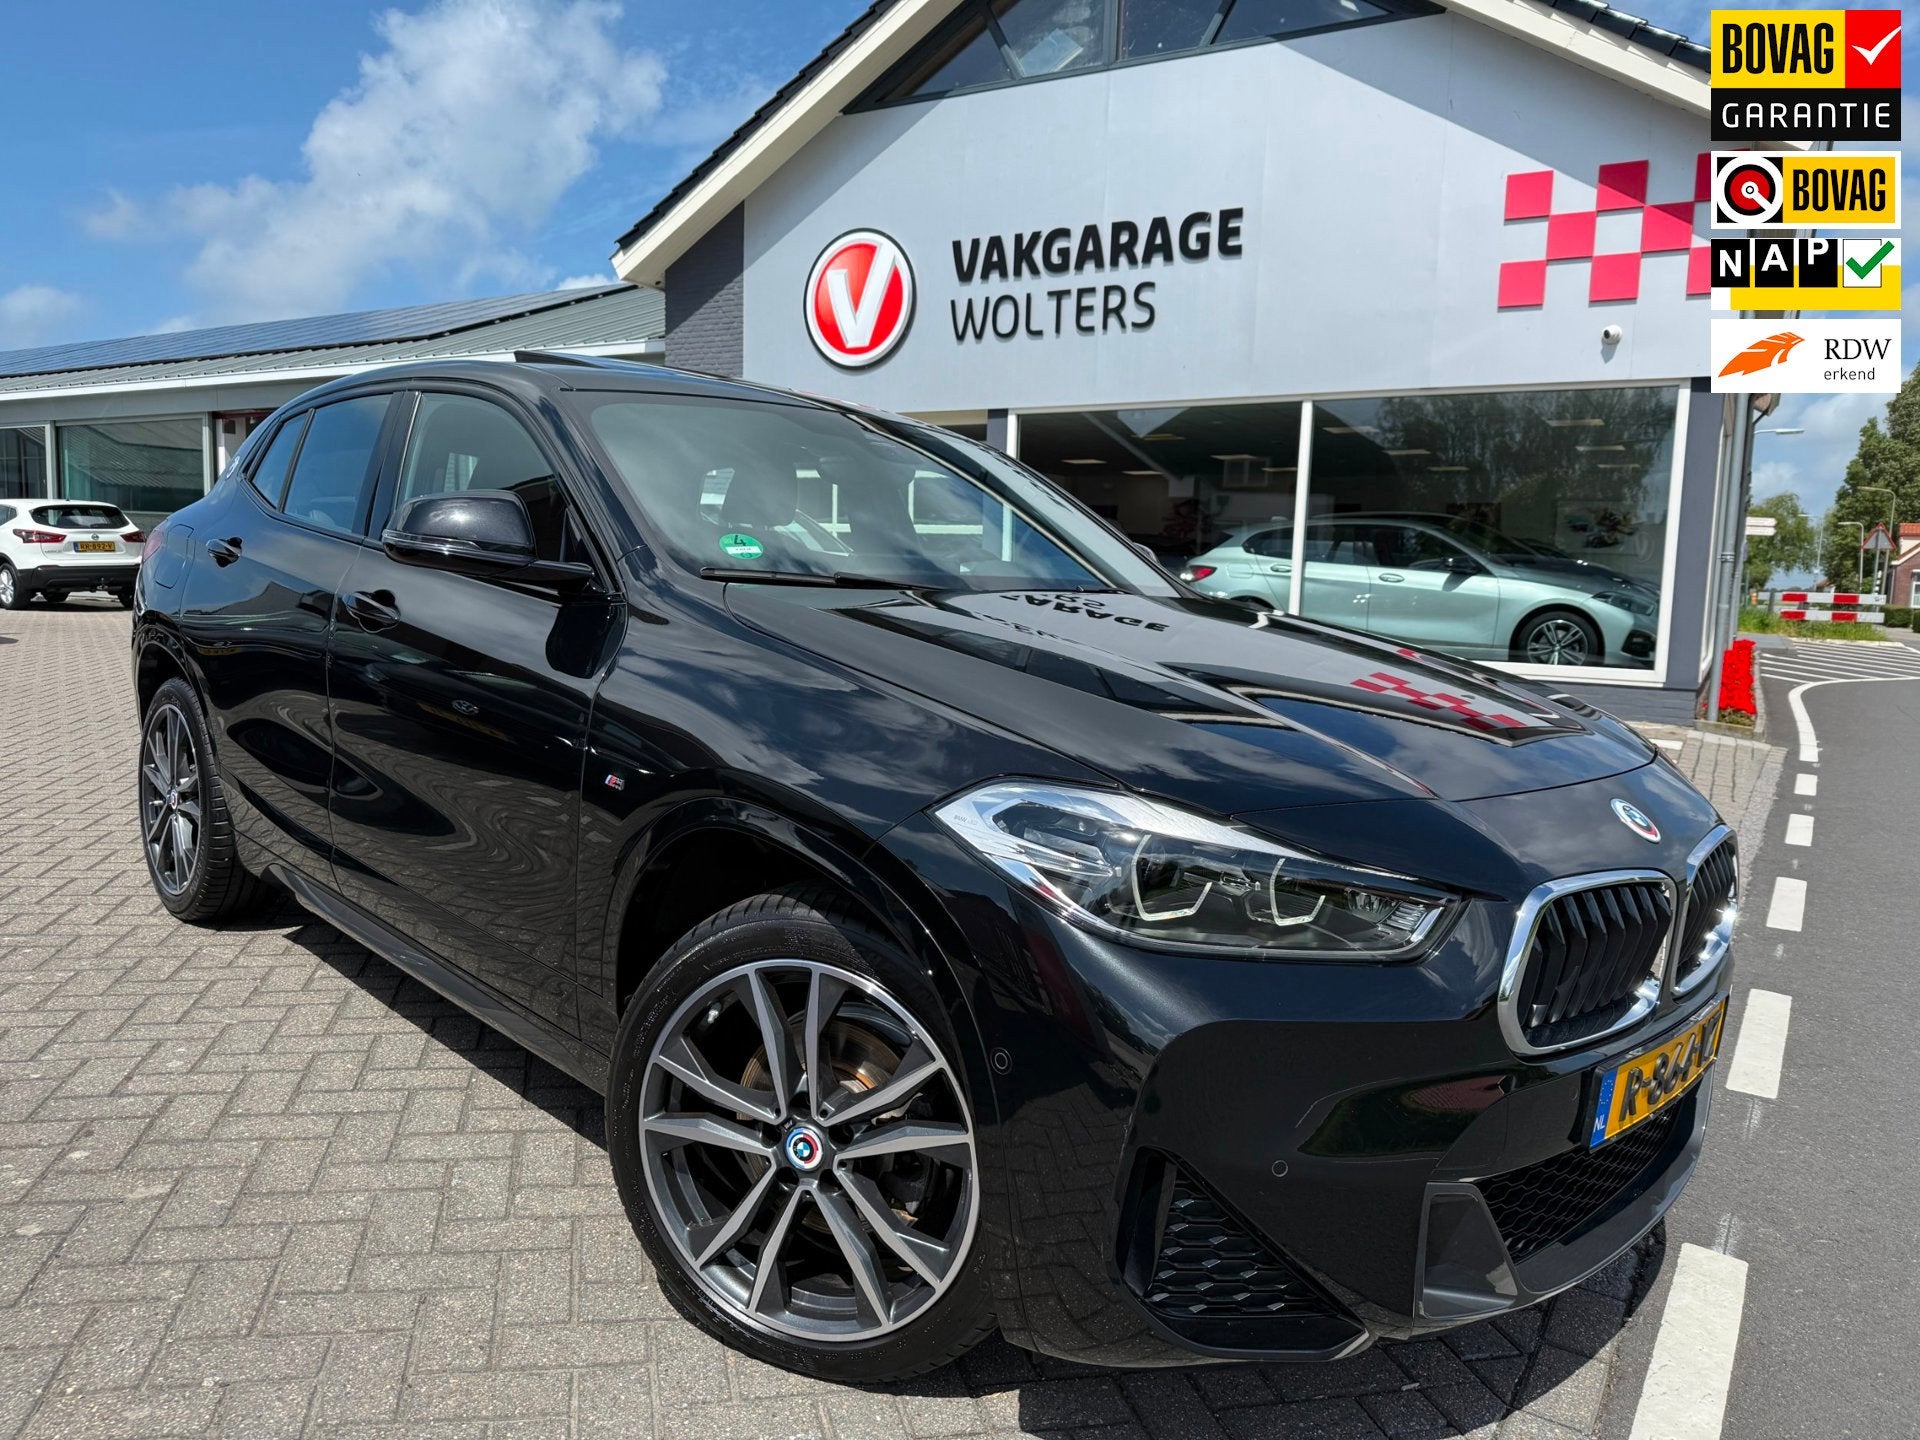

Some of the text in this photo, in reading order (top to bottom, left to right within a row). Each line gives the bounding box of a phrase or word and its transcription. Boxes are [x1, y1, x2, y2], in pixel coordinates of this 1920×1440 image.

[952, 207, 1244, 282] VAKGARAGE
[950, 281, 1156, 341] WOLTERS
[733, 534, 747, 546] 4
[1594, 1115, 1606, 1133] NL
